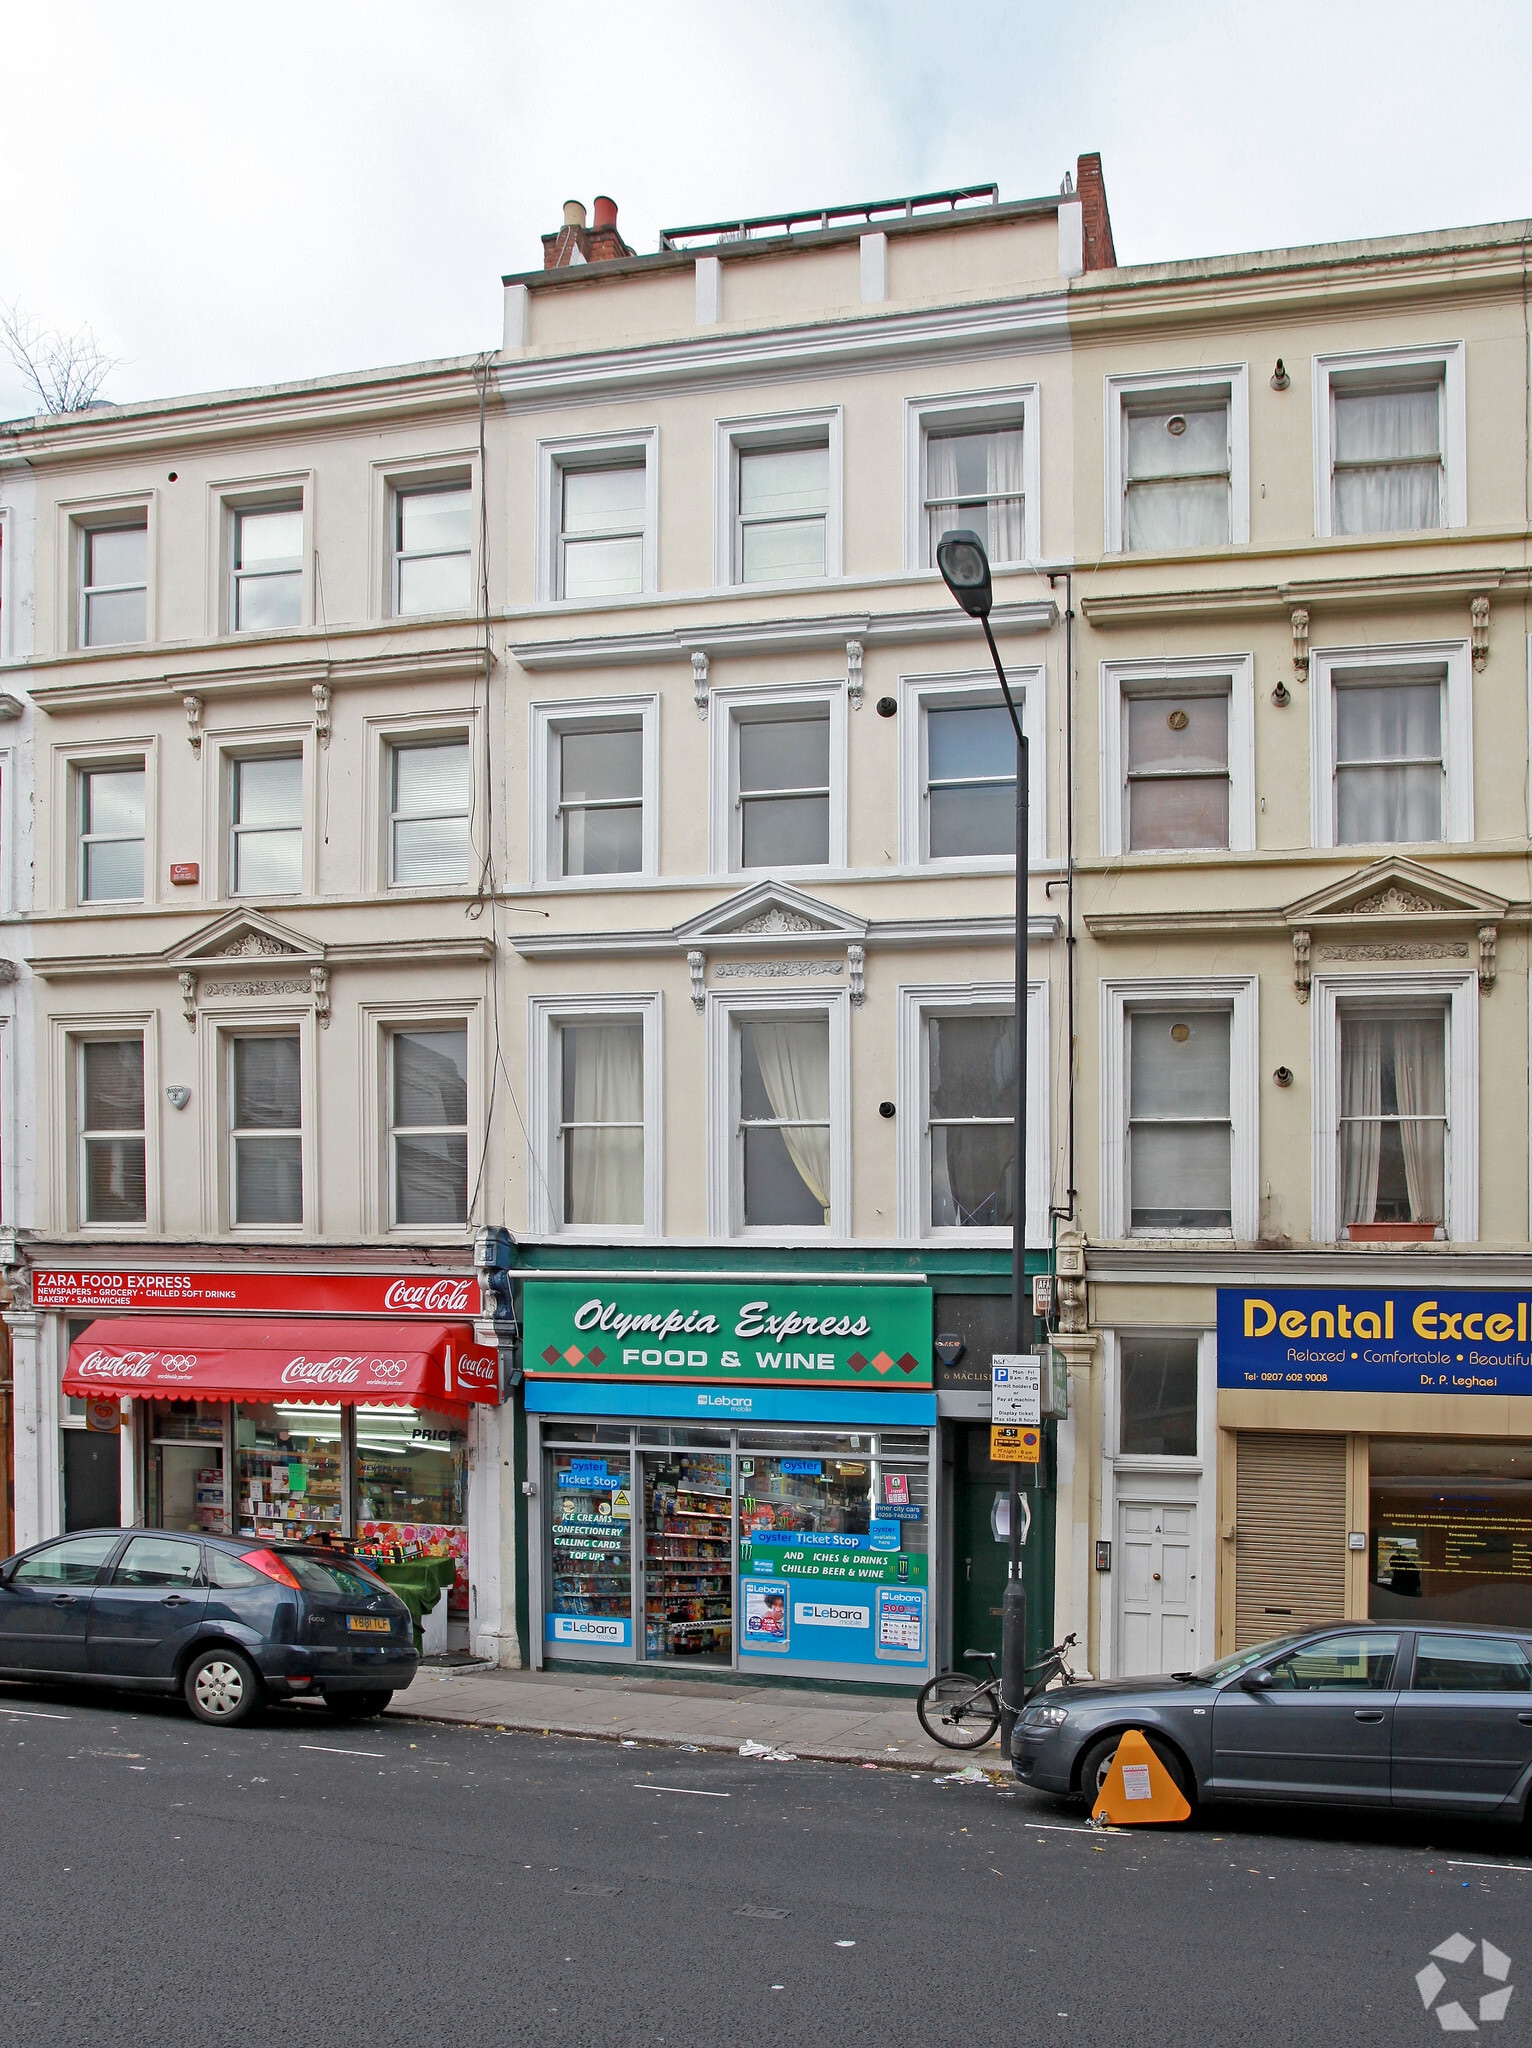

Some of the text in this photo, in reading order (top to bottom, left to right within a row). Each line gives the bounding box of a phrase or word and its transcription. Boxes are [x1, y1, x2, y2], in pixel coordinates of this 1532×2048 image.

[38, 1274, 191, 1288] ZARA FOOD EXPRESS
[38, 1288, 92, 1296] NEWSPAPERS
[182, 1290, 203, 1298] SOFT
[205, 1290, 236, 1298] DRINKS
[384, 1279, 473, 1310] Coca-Cola
[574, 1298, 871, 1344] Olympia Express
[1244, 1298, 1532, 1342] Dental Excel
[622, 1348, 835, 1370] FOOD & WINE
[1287, 1348, 1346, 1362] Relaxed
[1363, 1349, 1451, 1364] Comfortable
[78, 1350, 160, 1378] Coca-Cola
[281, 1356, 368, 1384] Coca-Cola
[458, 1353, 495, 1380] Coca-Cola
[953, 1372, 992, 1380] MACLIS
[1260, 1372, 1284, 1382] 0207
[1286, 1373, 1304, 1382] 602
[1305, 1373, 1328, 1382] 9008
[1420, 1374, 1498, 1388] Dr. P. Leghaei
[708, 1394, 752, 1407] Lebara
[360, 1464, 412, 1474] NEWSPAPERS
[572, 1462, 604, 1471] oyster
[784, 1461, 818, 1471] oyster
[559, 1474, 618, 1489] Ticket Stop
[562, 1513, 575, 1521] ICE
[577, 1513, 612, 1523] CREAMS
[552, 1525, 623, 1536] CONFECTIONERY
[1155, 1525, 1162, 1533] 4
[554, 1537, 621, 1549] CALLING CARDS
[758, 1533, 859, 1548] oyster Ticket Stop
[570, 1551, 605, 1561] TOP UPS
[784, 1552, 804, 1560] AND
[842, 1554, 850, 1563] &
[853, 1555, 888, 1565] DRINKS
[781, 1564, 884, 1578] CHILLED BEER & WINE
[754, 1585, 784, 1594] Lebara
[889, 1592, 921, 1602] Lebara
[814, 1606, 862, 1620] Lebara
[883, 1604, 905, 1614] 500
[574, 1622, 617, 1635] Lebara
